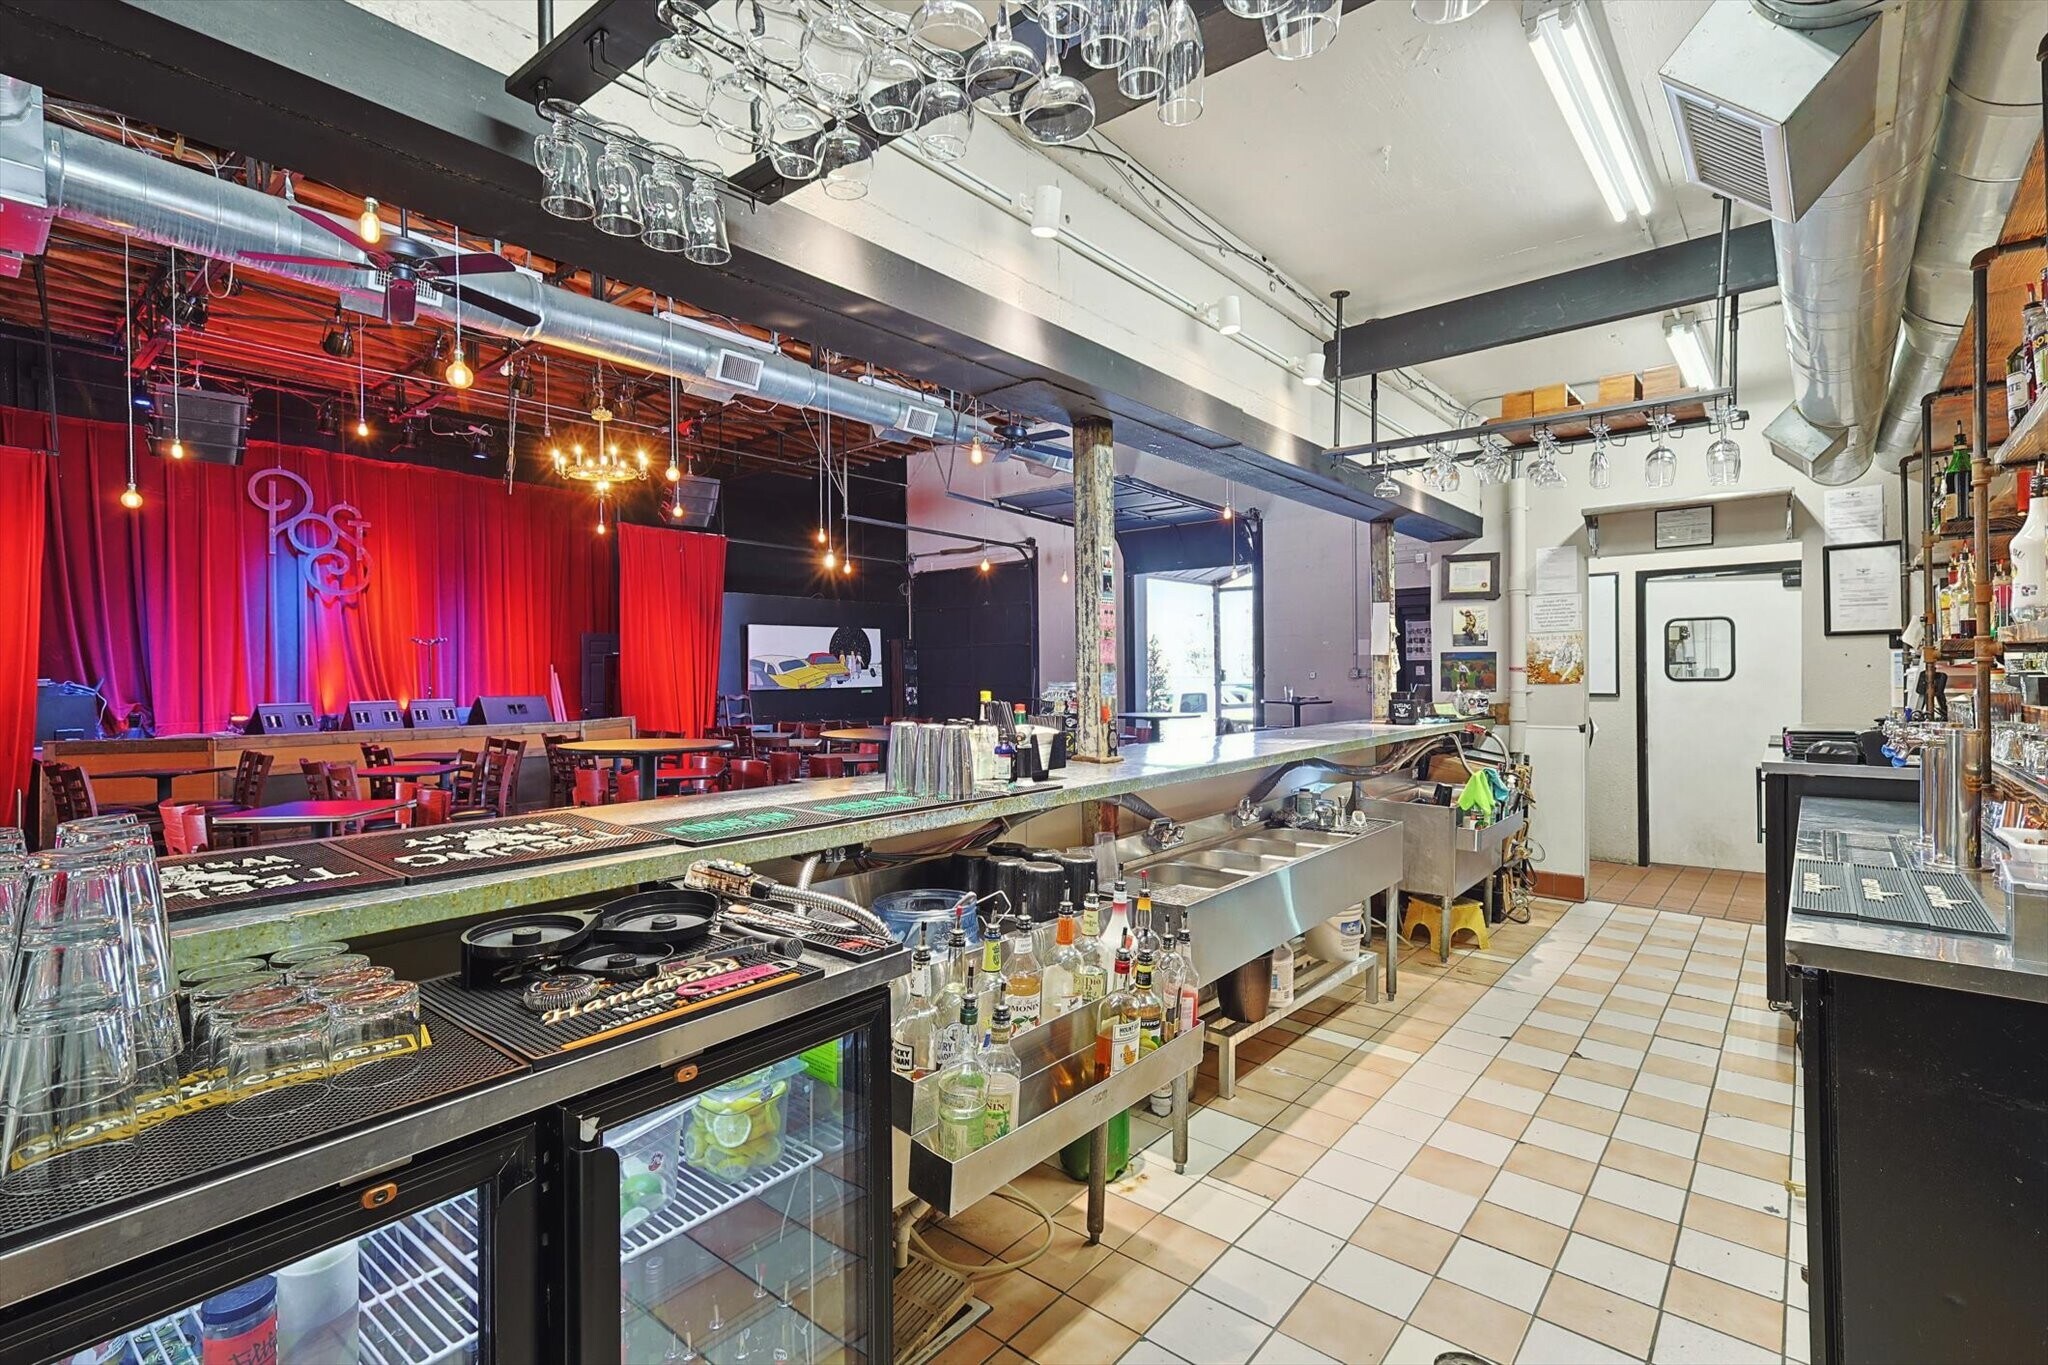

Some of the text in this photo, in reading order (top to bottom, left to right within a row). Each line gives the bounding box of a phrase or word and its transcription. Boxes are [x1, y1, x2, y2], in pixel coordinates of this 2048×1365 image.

[162, 866, 360, 900] TEEL
[541, 957, 741, 1027] Handmade
[611, 991, 677, 1013] VOD
[985, 1101, 1006, 1111] NIN
